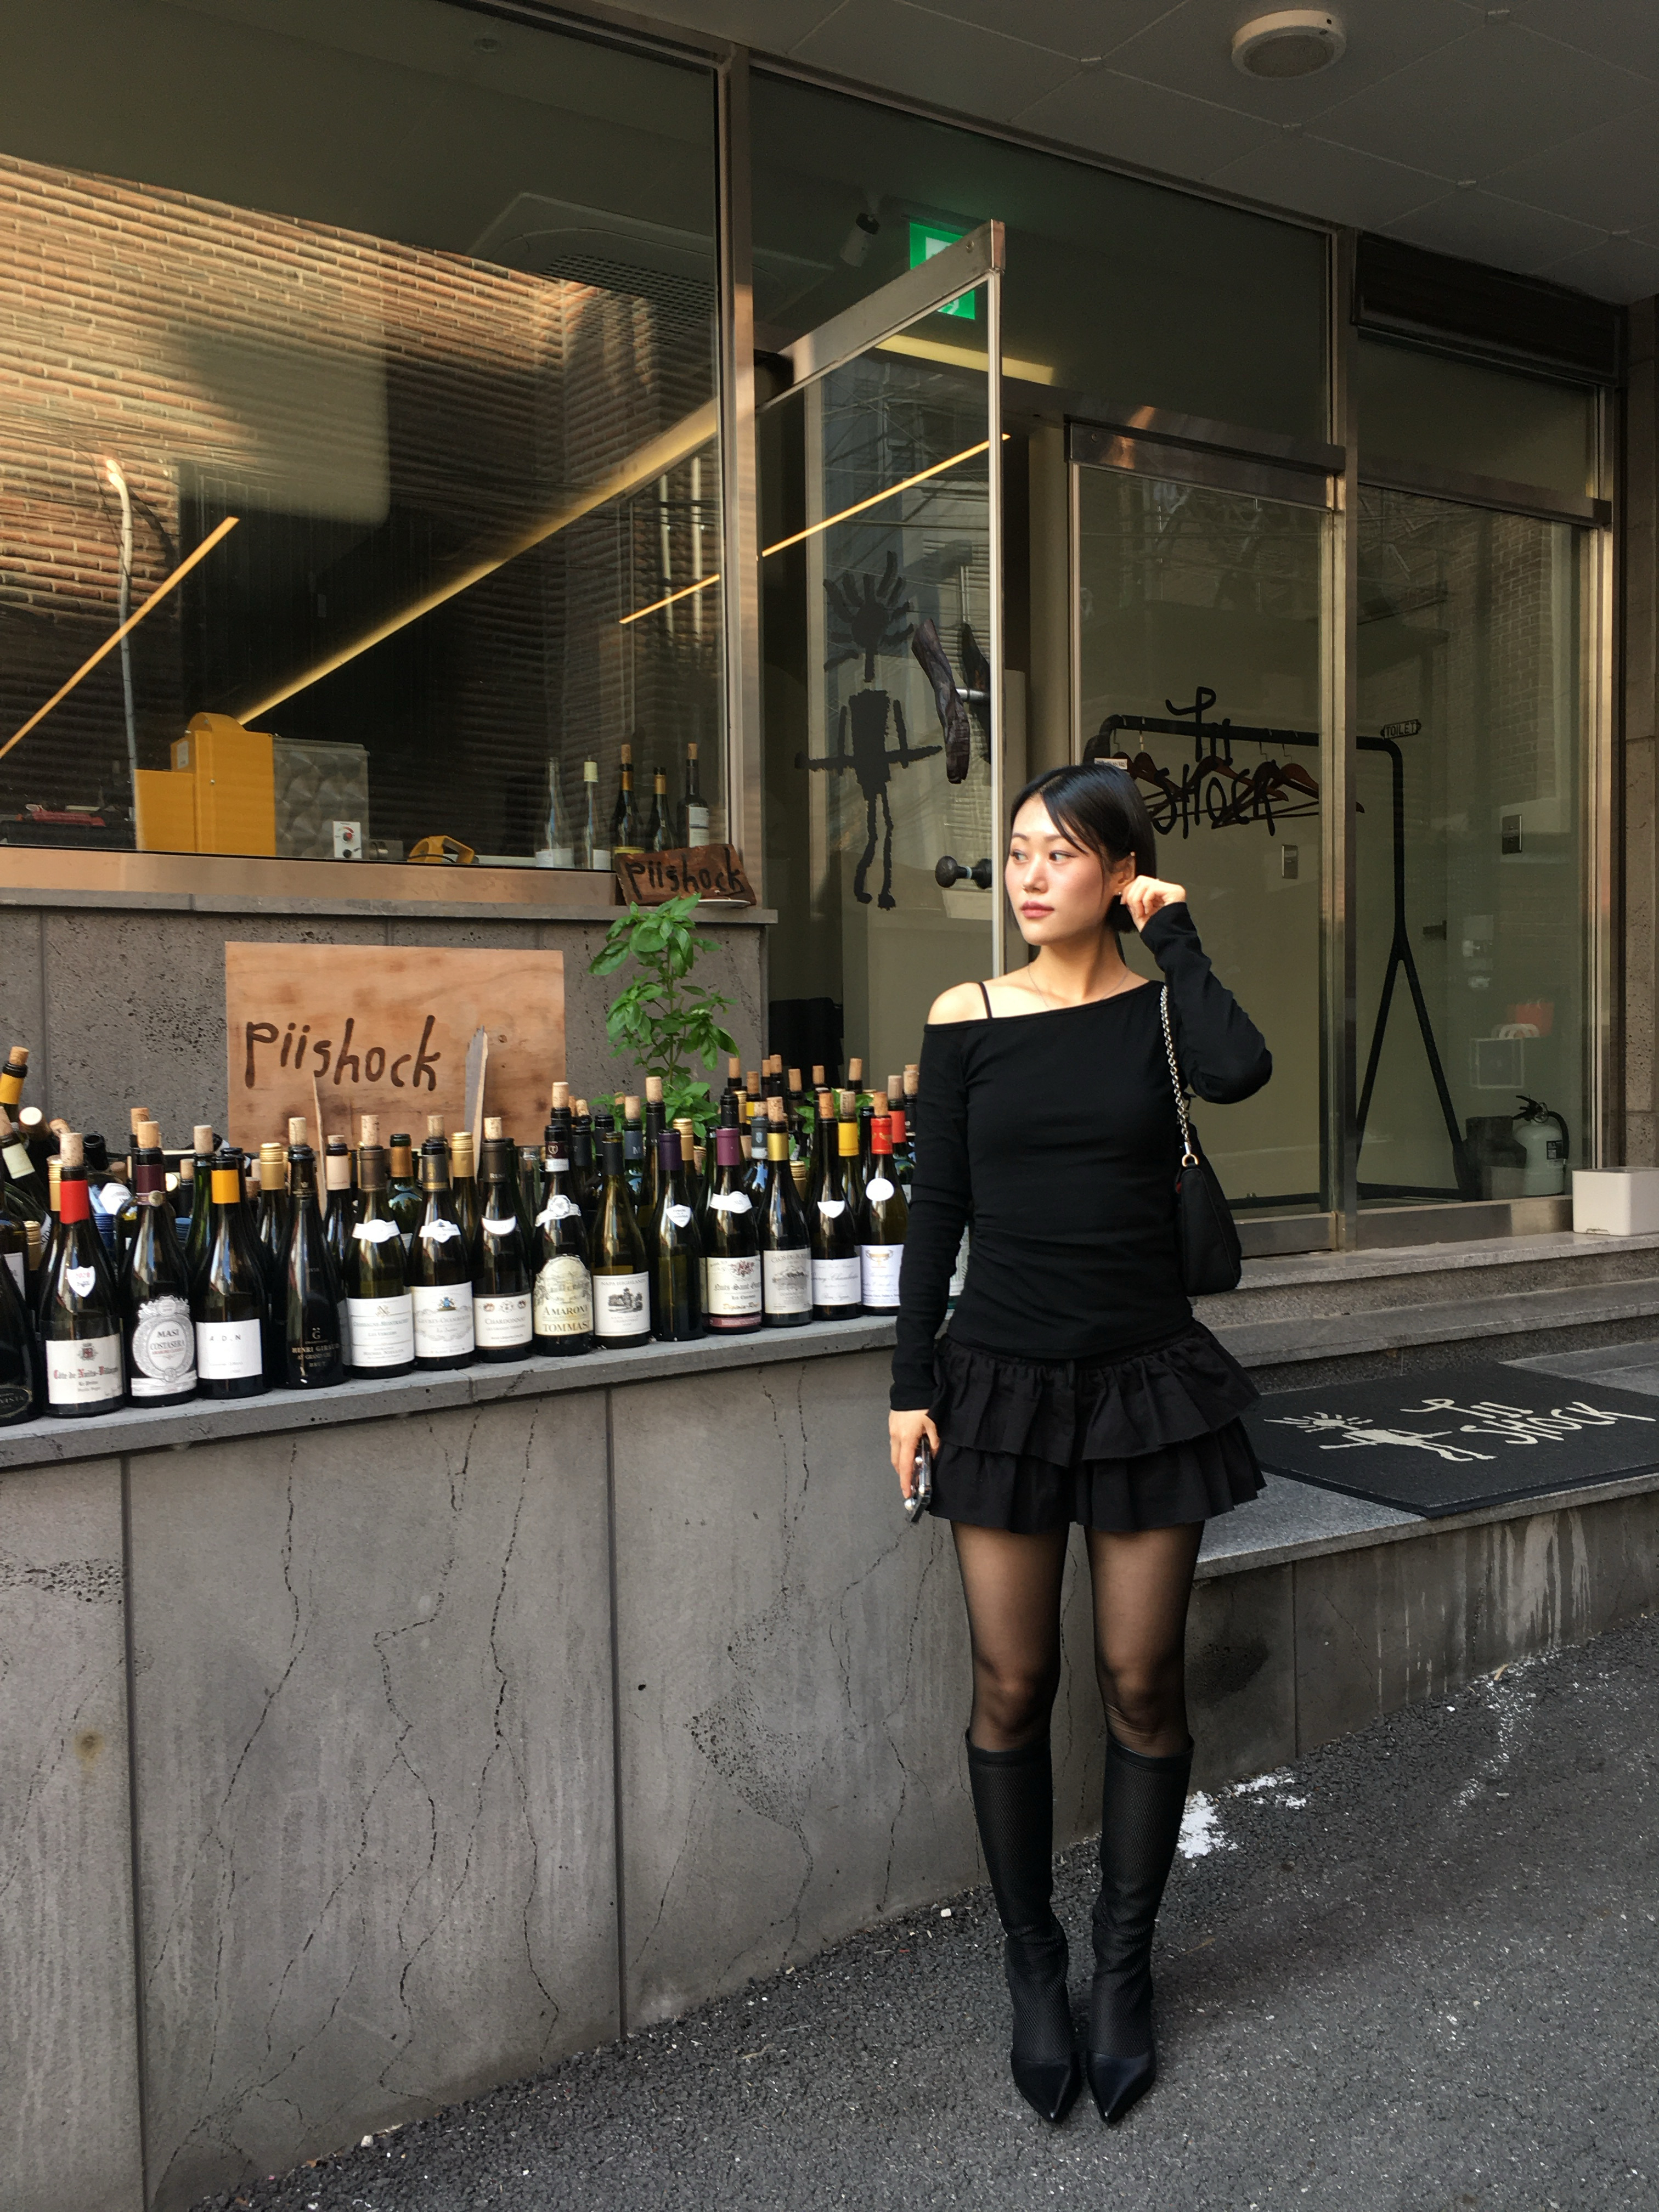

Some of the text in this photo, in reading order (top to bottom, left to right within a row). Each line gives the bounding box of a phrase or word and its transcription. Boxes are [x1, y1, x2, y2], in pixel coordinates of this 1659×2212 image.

[1386, 720, 1417, 737] TOILET
[156, 1329, 179, 1339] MASI
[150, 1339, 185, 1351] COSTASERA
[1459, 1401, 1657, 1445] SHOCK
